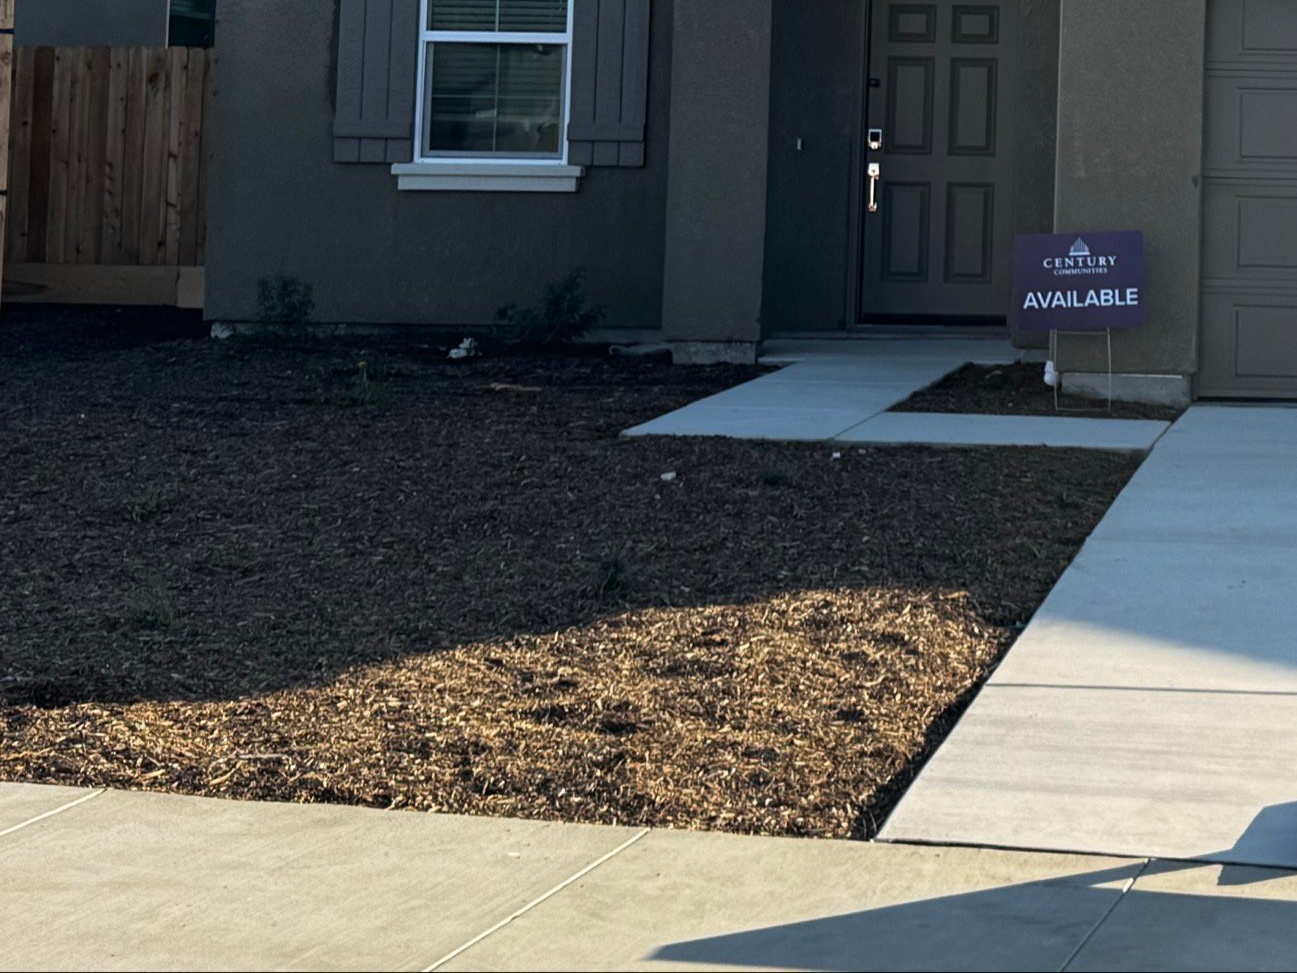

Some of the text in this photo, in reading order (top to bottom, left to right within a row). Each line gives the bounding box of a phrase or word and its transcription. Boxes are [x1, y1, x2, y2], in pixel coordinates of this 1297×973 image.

[1043, 256, 1117, 269] CENTURY
[1053, 267, 1108, 276] COMMUNITIES
[1023, 288, 1138, 309] AVAILABLE
